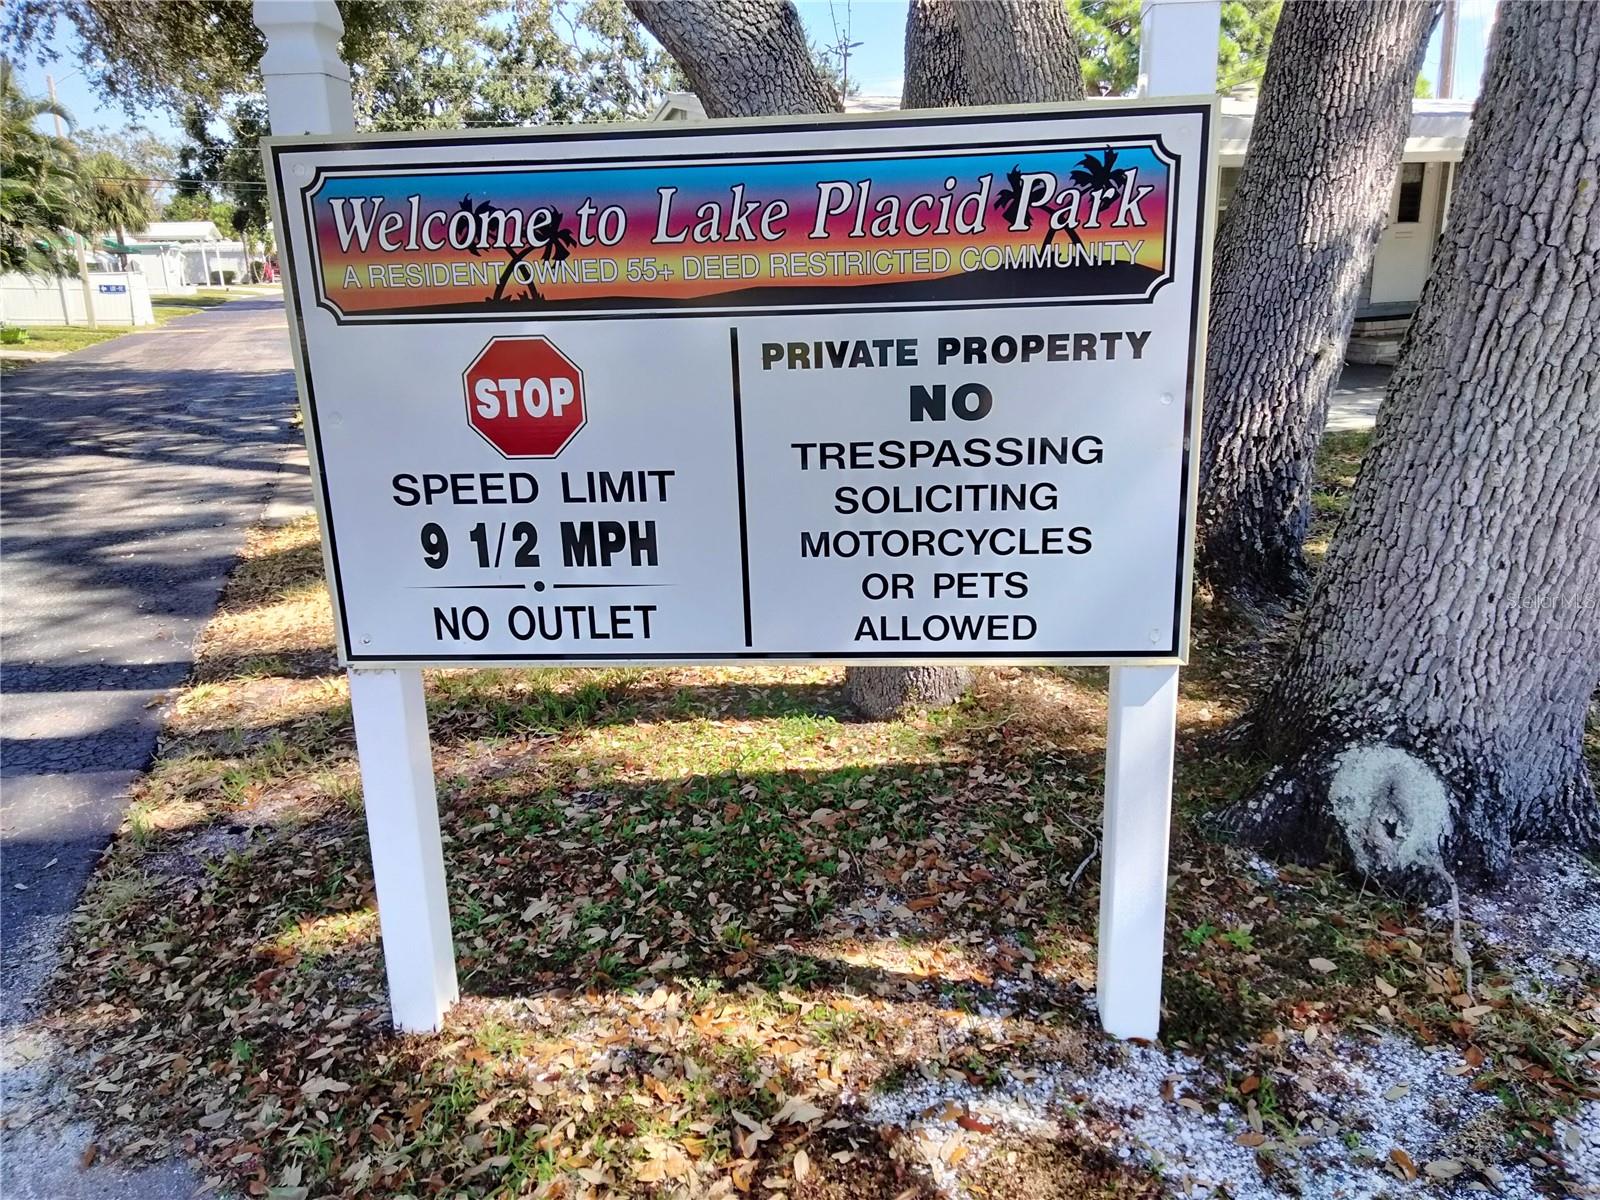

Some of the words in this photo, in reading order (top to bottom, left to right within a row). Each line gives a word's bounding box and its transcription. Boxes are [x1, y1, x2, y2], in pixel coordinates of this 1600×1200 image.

[329, 193, 553, 255] Welcome
[576, 196, 628, 248] to
[650, 183, 789, 245] Lake
[808, 172, 993, 240] Placid
[1008, 166, 1154, 233] Park
[342, 265, 363, 290] A
[367, 261, 504, 288] RESIDENT
[513, 259, 618, 285] OWNED
[626, 257, 674, 283] 55+
[683, 254, 760, 281] DEED
[768, 248, 952, 279] RESTRICTED
[959, 240, 1145, 272] COMMUNITY
[761, 338, 918, 370] PRIVATE
[938, 331, 1152, 366] PROPERTY
[474, 376, 575, 420] STOP
[909, 382, 993, 422] NO
[791, 435, 1104, 470] TRESPASSING
[392, 472, 539, 506] SPEED
[561, 470, 675, 503] LIMIT
[834, 482, 1058, 515] SOLICITING
[420, 522, 449, 569] 9
[469, 521, 541, 568] 1/2
[560, 520, 659, 567] MPH
[800, 526, 1093, 558] MOTORCYCLES
[861, 573, 915, 600] OR
[933, 571, 1029, 599] PETS
[433, 605, 490, 641] NO
[508, 604, 657, 641] OUTLET
[853, 614, 1037, 641] ALLOWED
